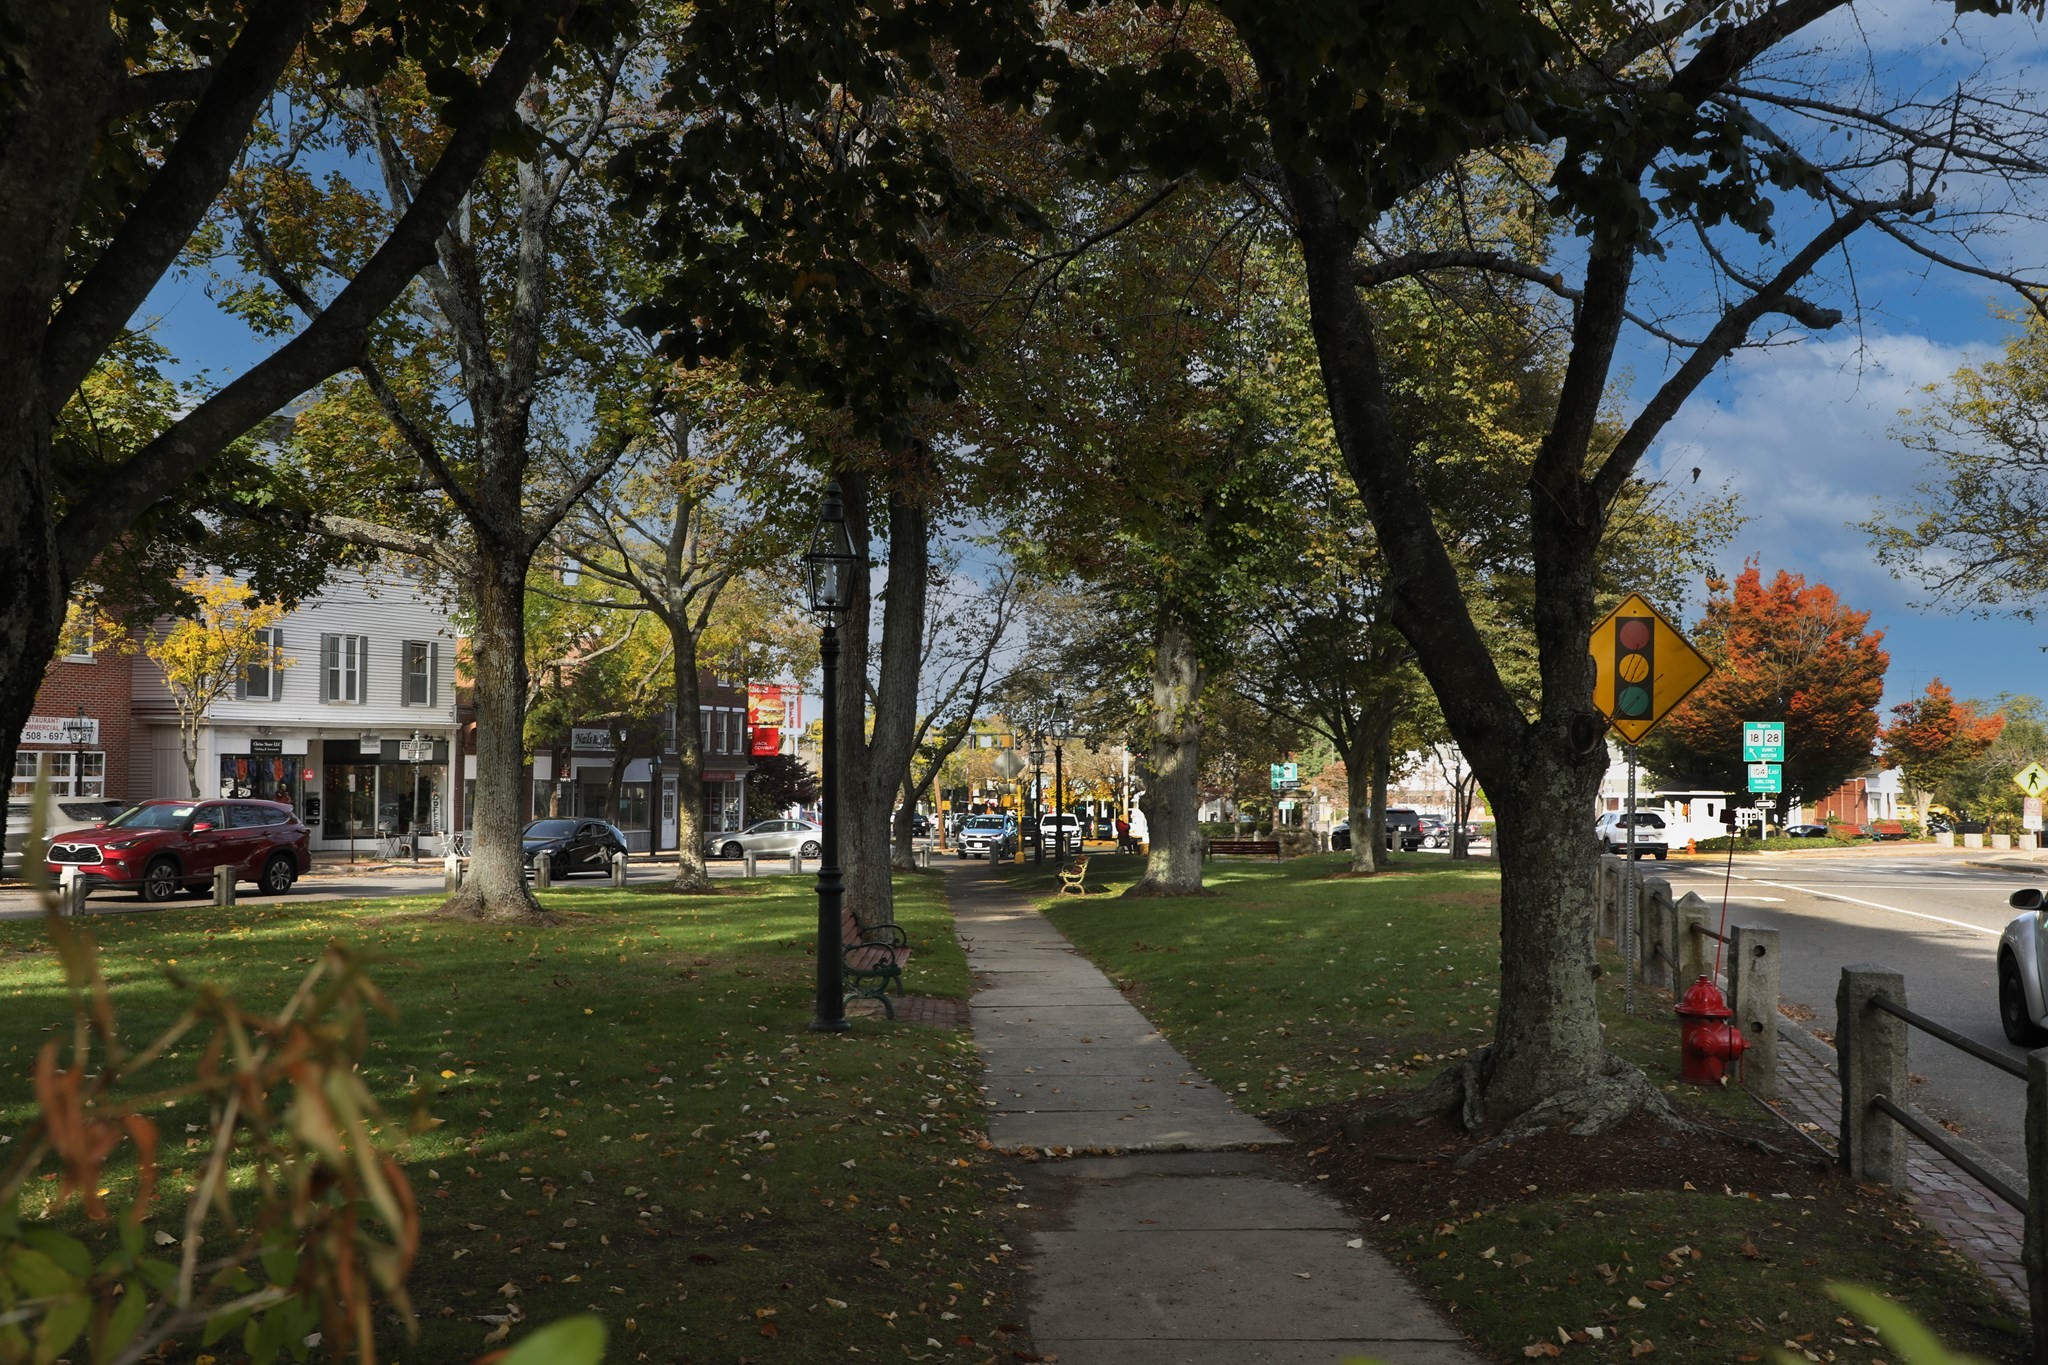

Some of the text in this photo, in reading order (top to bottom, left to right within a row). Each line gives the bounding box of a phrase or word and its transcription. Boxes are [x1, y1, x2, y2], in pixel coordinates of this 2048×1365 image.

[62, 721, 94, 732] AVAILBLE
[26, 732, 41, 740] 508
[575, 732, 592, 744] Nails
[1750, 734, 1779, 742] 18 28
